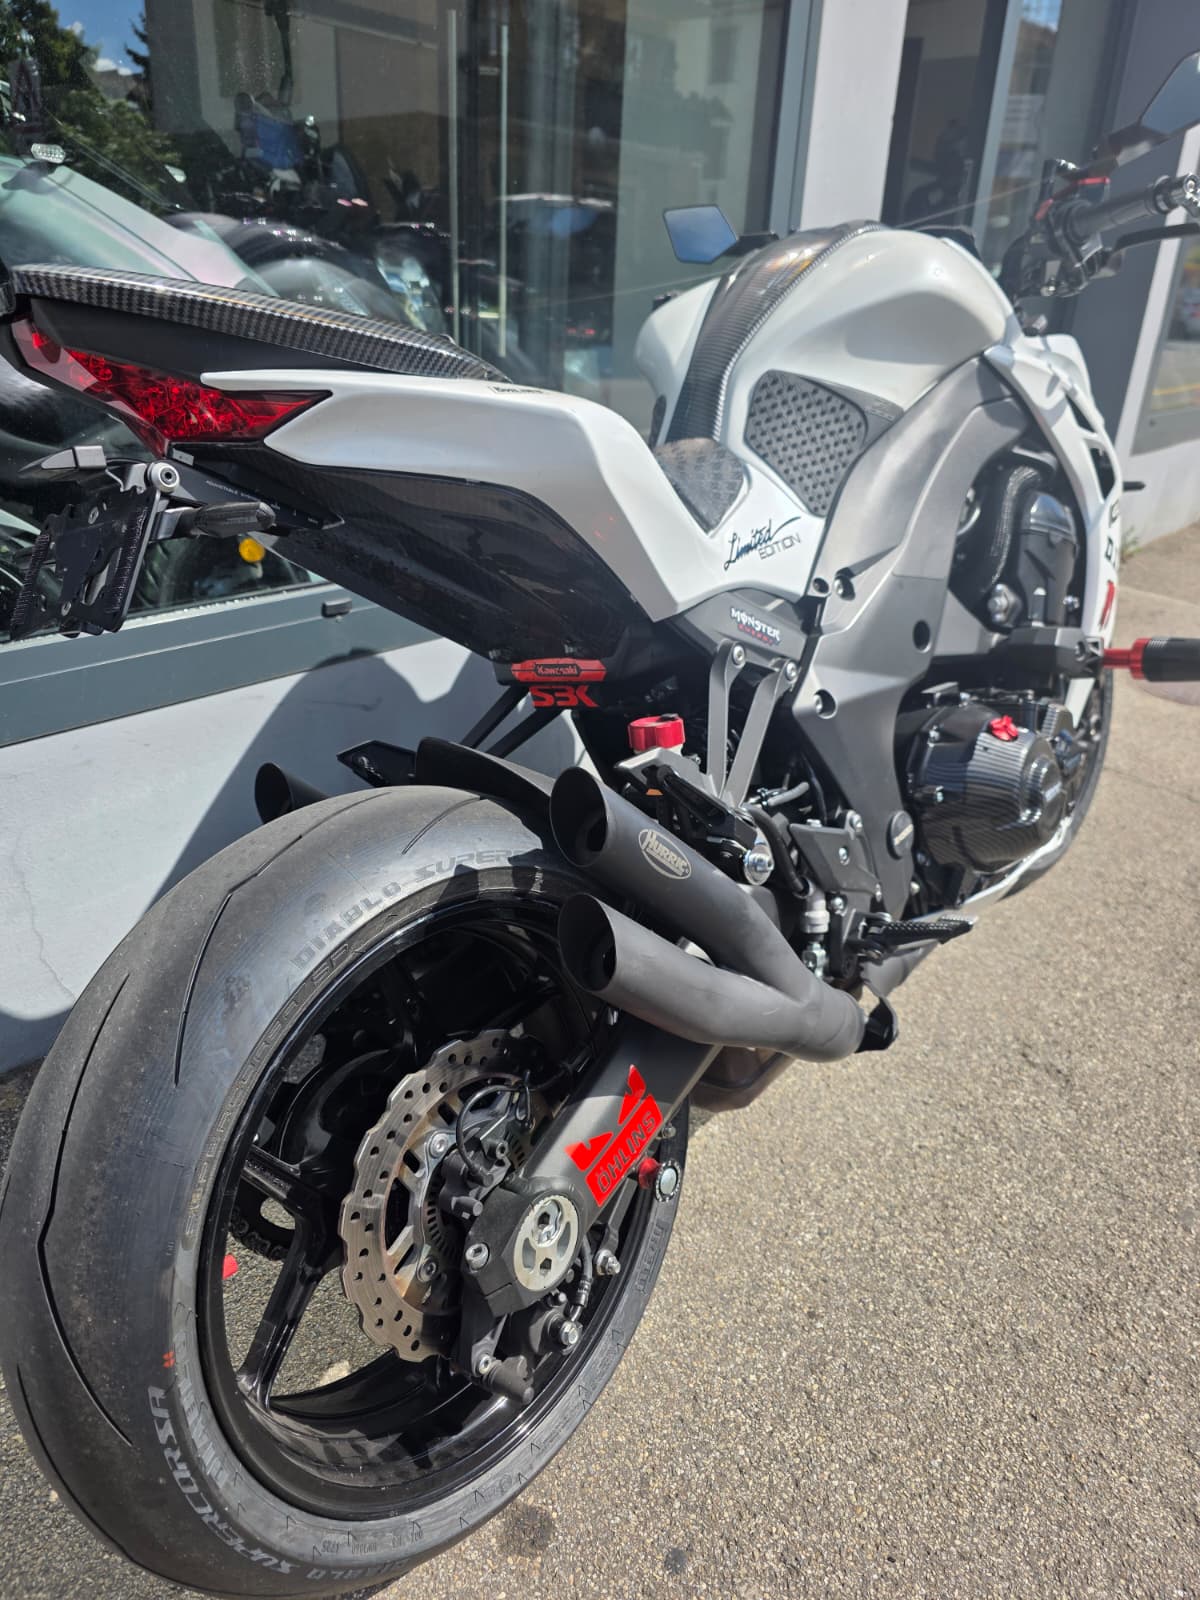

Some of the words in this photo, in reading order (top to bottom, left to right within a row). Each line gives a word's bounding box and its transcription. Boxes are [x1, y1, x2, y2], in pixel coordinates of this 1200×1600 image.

[731, 607, 780, 642] MONSTER
[537, 664, 578, 676] Kawasaki
[289, 881, 402, 970] DIABLO
[414, 849, 527, 882] SUPER
[596, 1110, 656, 1192] ÖHLINS
[148, 1386, 297, 1574] SUPERCORSA
